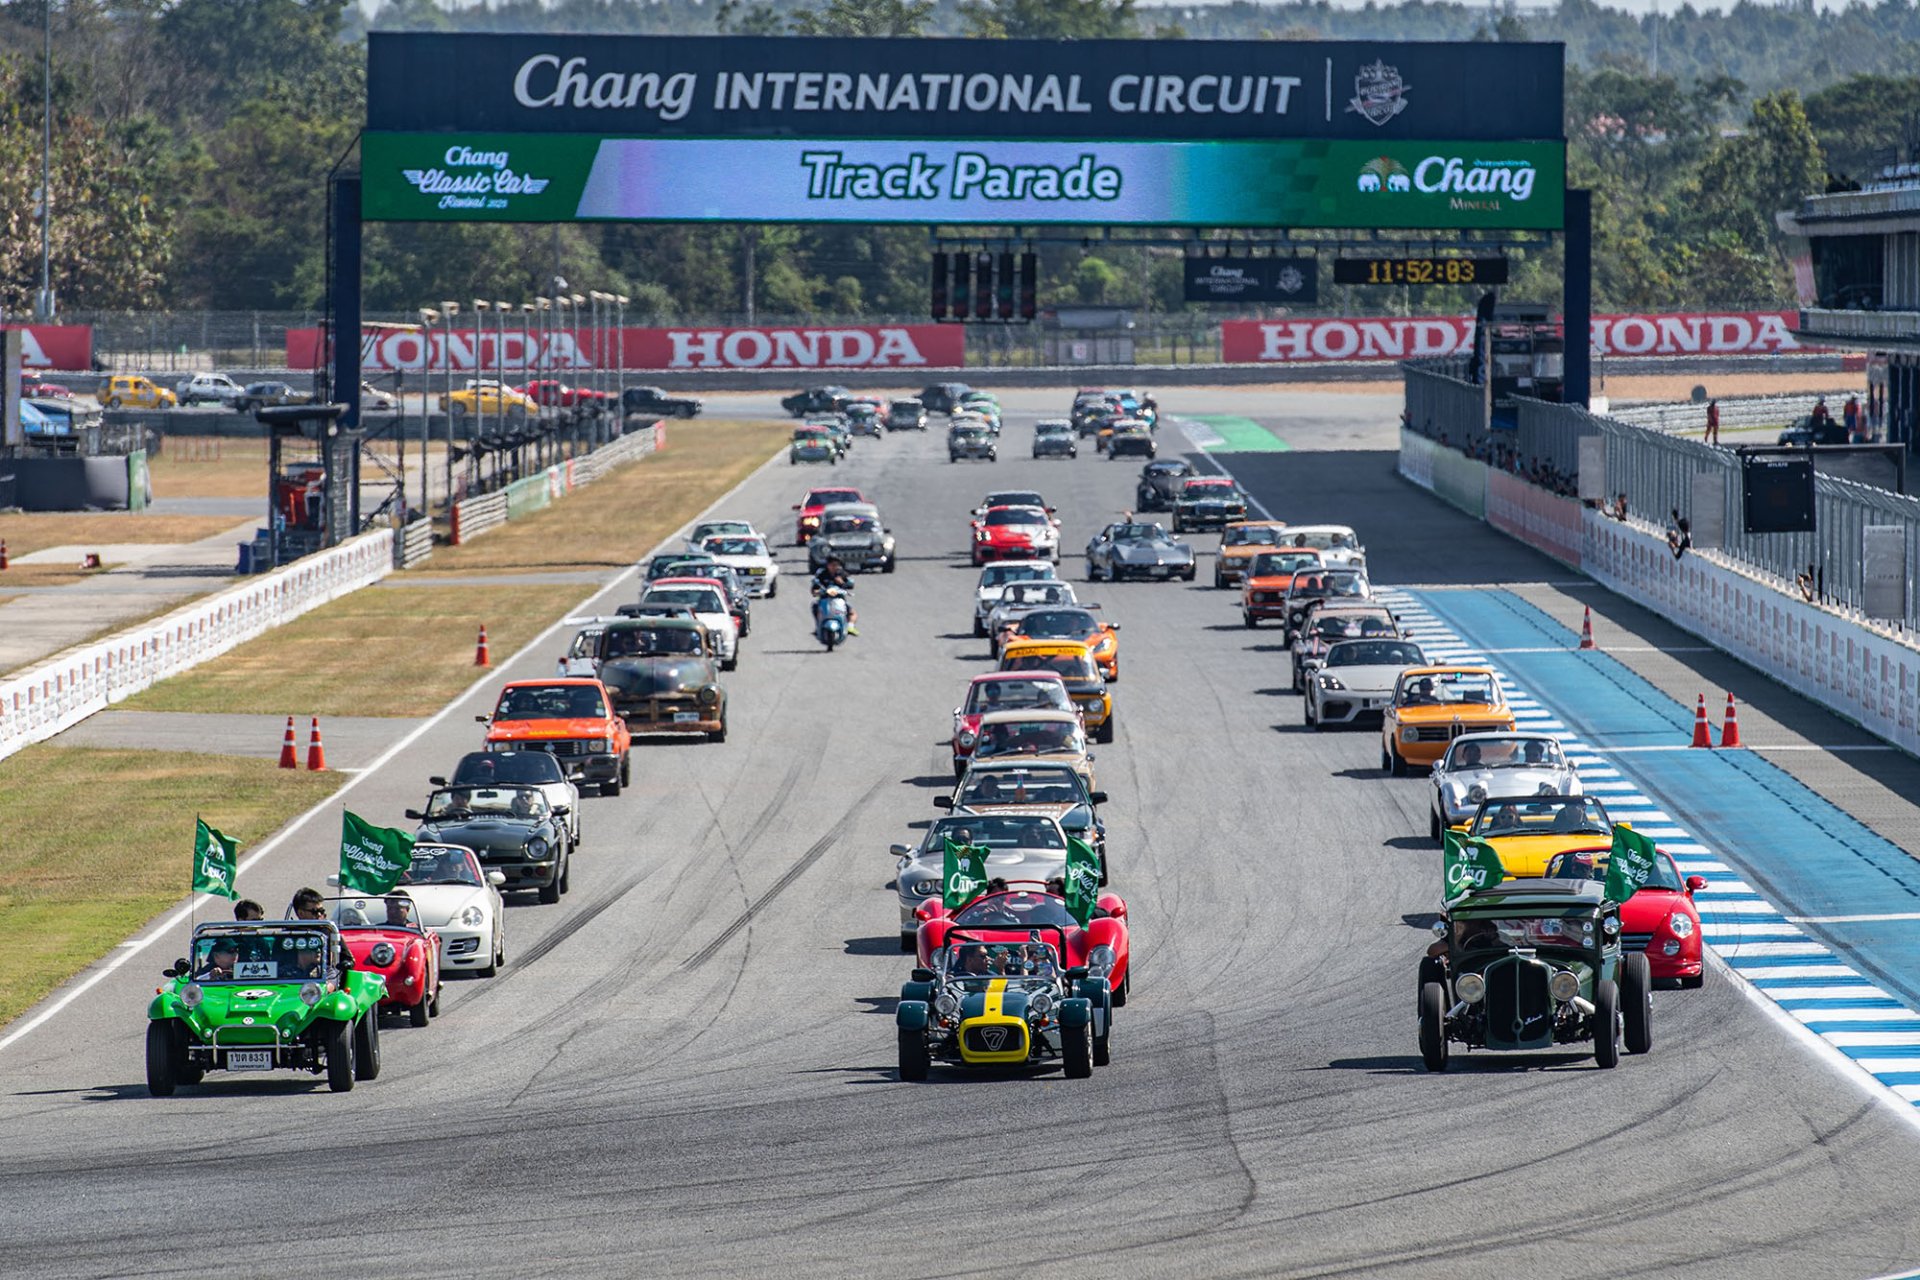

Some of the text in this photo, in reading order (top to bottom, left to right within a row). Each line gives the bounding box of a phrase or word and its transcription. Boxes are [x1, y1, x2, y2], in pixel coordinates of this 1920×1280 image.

[514, 54, 1301, 120] Chang INTERNATIONAL CIRCUIT
[444, 146, 509, 169] Chang
[418, 168, 533, 194] Classic Car
[801, 151, 1122, 201] Track Parade
[1413, 156, 1536, 201] Chang
[1210, 265, 1244, 278] Chang
[1368, 260, 1475, 283] 11:52:03
[667, 329, 927, 367] HONDA
[248, 1053, 270, 1063] 8331
